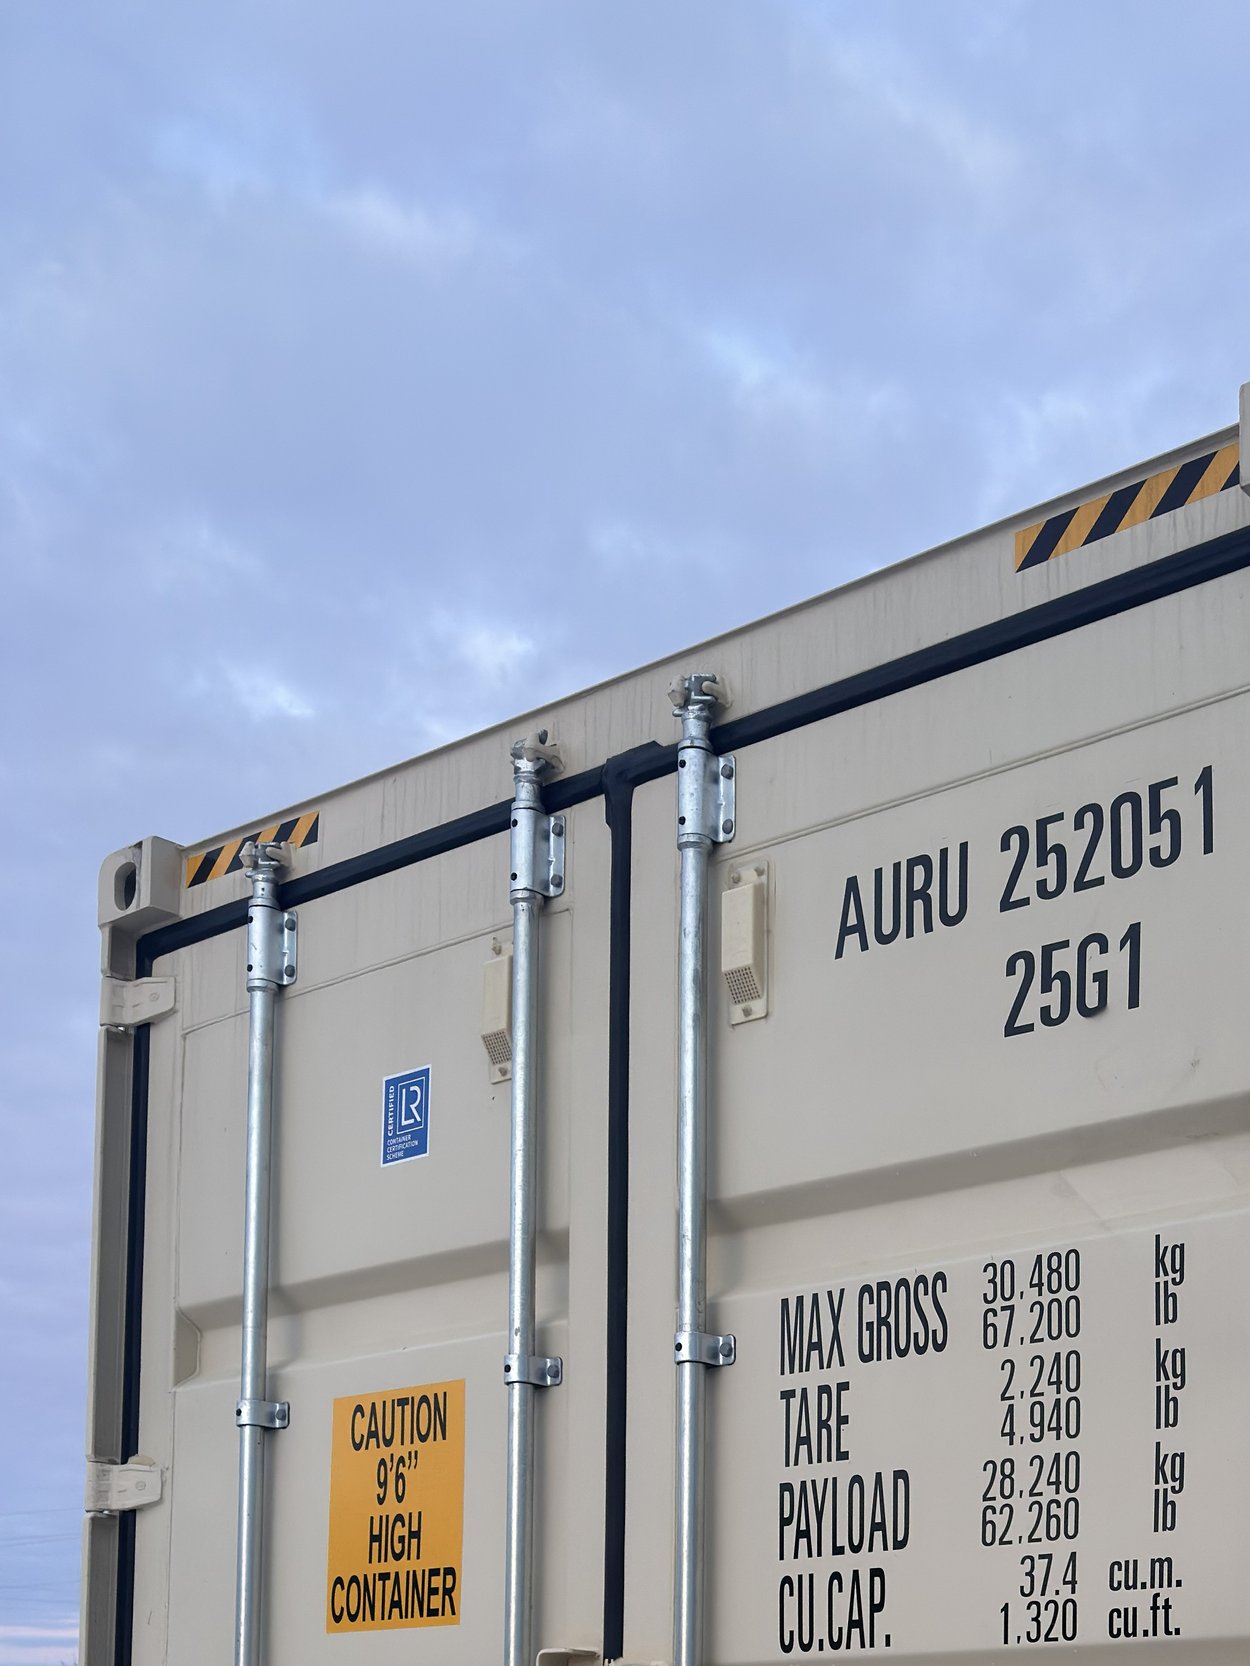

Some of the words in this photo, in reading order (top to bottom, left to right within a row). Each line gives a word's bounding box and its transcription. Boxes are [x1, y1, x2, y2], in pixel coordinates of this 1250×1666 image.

[835, 841, 969, 959] AURU
[999, 765, 1213, 912] 252051
[1004, 921, 1142, 1037] 25G1
[387, 1085, 395, 1136] CERTIFIED
[401, 1085, 422, 1126] LR
[386, 1140, 419, 1153] CERTIFICATION
[386, 1151, 404, 1160] SCHEME
[387, 1134, 412, 1146] CONTAINER
[780, 1288, 846, 1376] MAX
[857, 1271, 949, 1364] GROSS
[982, 1248, 1081, 1305] 30,480
[1154, 1234, 1186, 1287] kg
[982, 1295, 1081, 1350] 67,200
[1154, 1281, 1179, 1326] lb
[351, 1391, 447, 1451] CAUTION
[779, 1381, 850, 1468] TARE
[1000, 1350, 1081, 1402] 2,240
[1154, 1338, 1186, 1391] kg
[1000, 1396, 1081, 1446] 4,940
[1154, 1385, 1179, 1430] lb
[778, 1469, 911, 1561] PAYLOAD
[982, 1450, 1081, 1502] 28,240
[1154, 1441, 1186, 1495] kg
[980, 1497, 1080, 1547] 62,260
[1153, 1489, 1177, 1533] lb
[368, 1511, 422, 1564] HIGH
[331, 1566, 457, 1624] CONTAINER
[778, 1567, 892, 1654] CU.CAP.
[1019, 1551, 1078, 1598] 37.4
[1108, 1555, 1184, 1592] cu.m.
[1000, 1598, 1078, 1645] 1,320
[1108, 1593, 1182, 1639] cu.ft.
